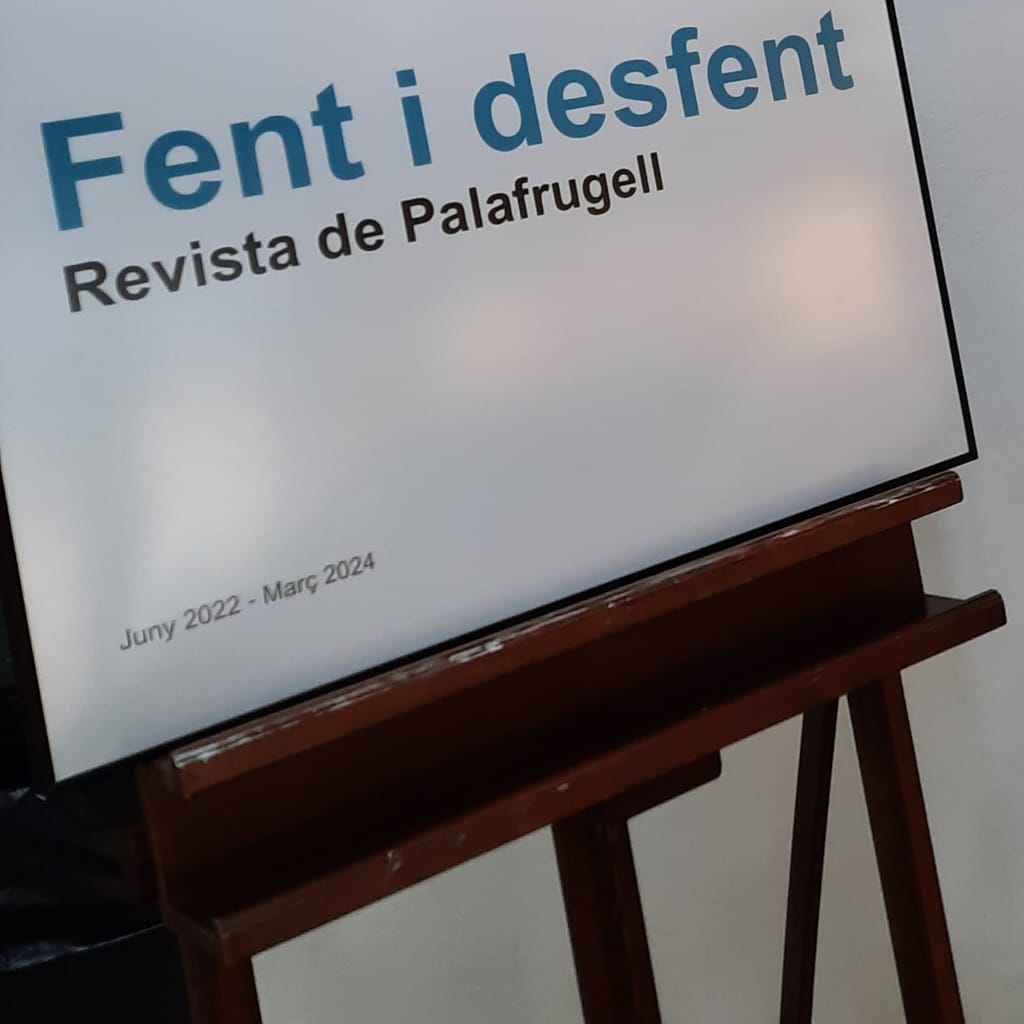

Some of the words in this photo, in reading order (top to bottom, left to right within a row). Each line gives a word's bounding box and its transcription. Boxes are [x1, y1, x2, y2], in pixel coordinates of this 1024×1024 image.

[40, 84, 365, 231] Fent
[396, 68, 432, 167] i
[473, 10, 854, 152] desfent
[62, 232, 300, 313] Revista
[317, 212, 384, 259] de
[400, 152, 664, 243] Palafrugell
[119, 618, 177, 650] Juny
[182, 594, 242, 630] 2022
[261, 573, 319, 605] Març
[321, 551, 376, 585] 2024
